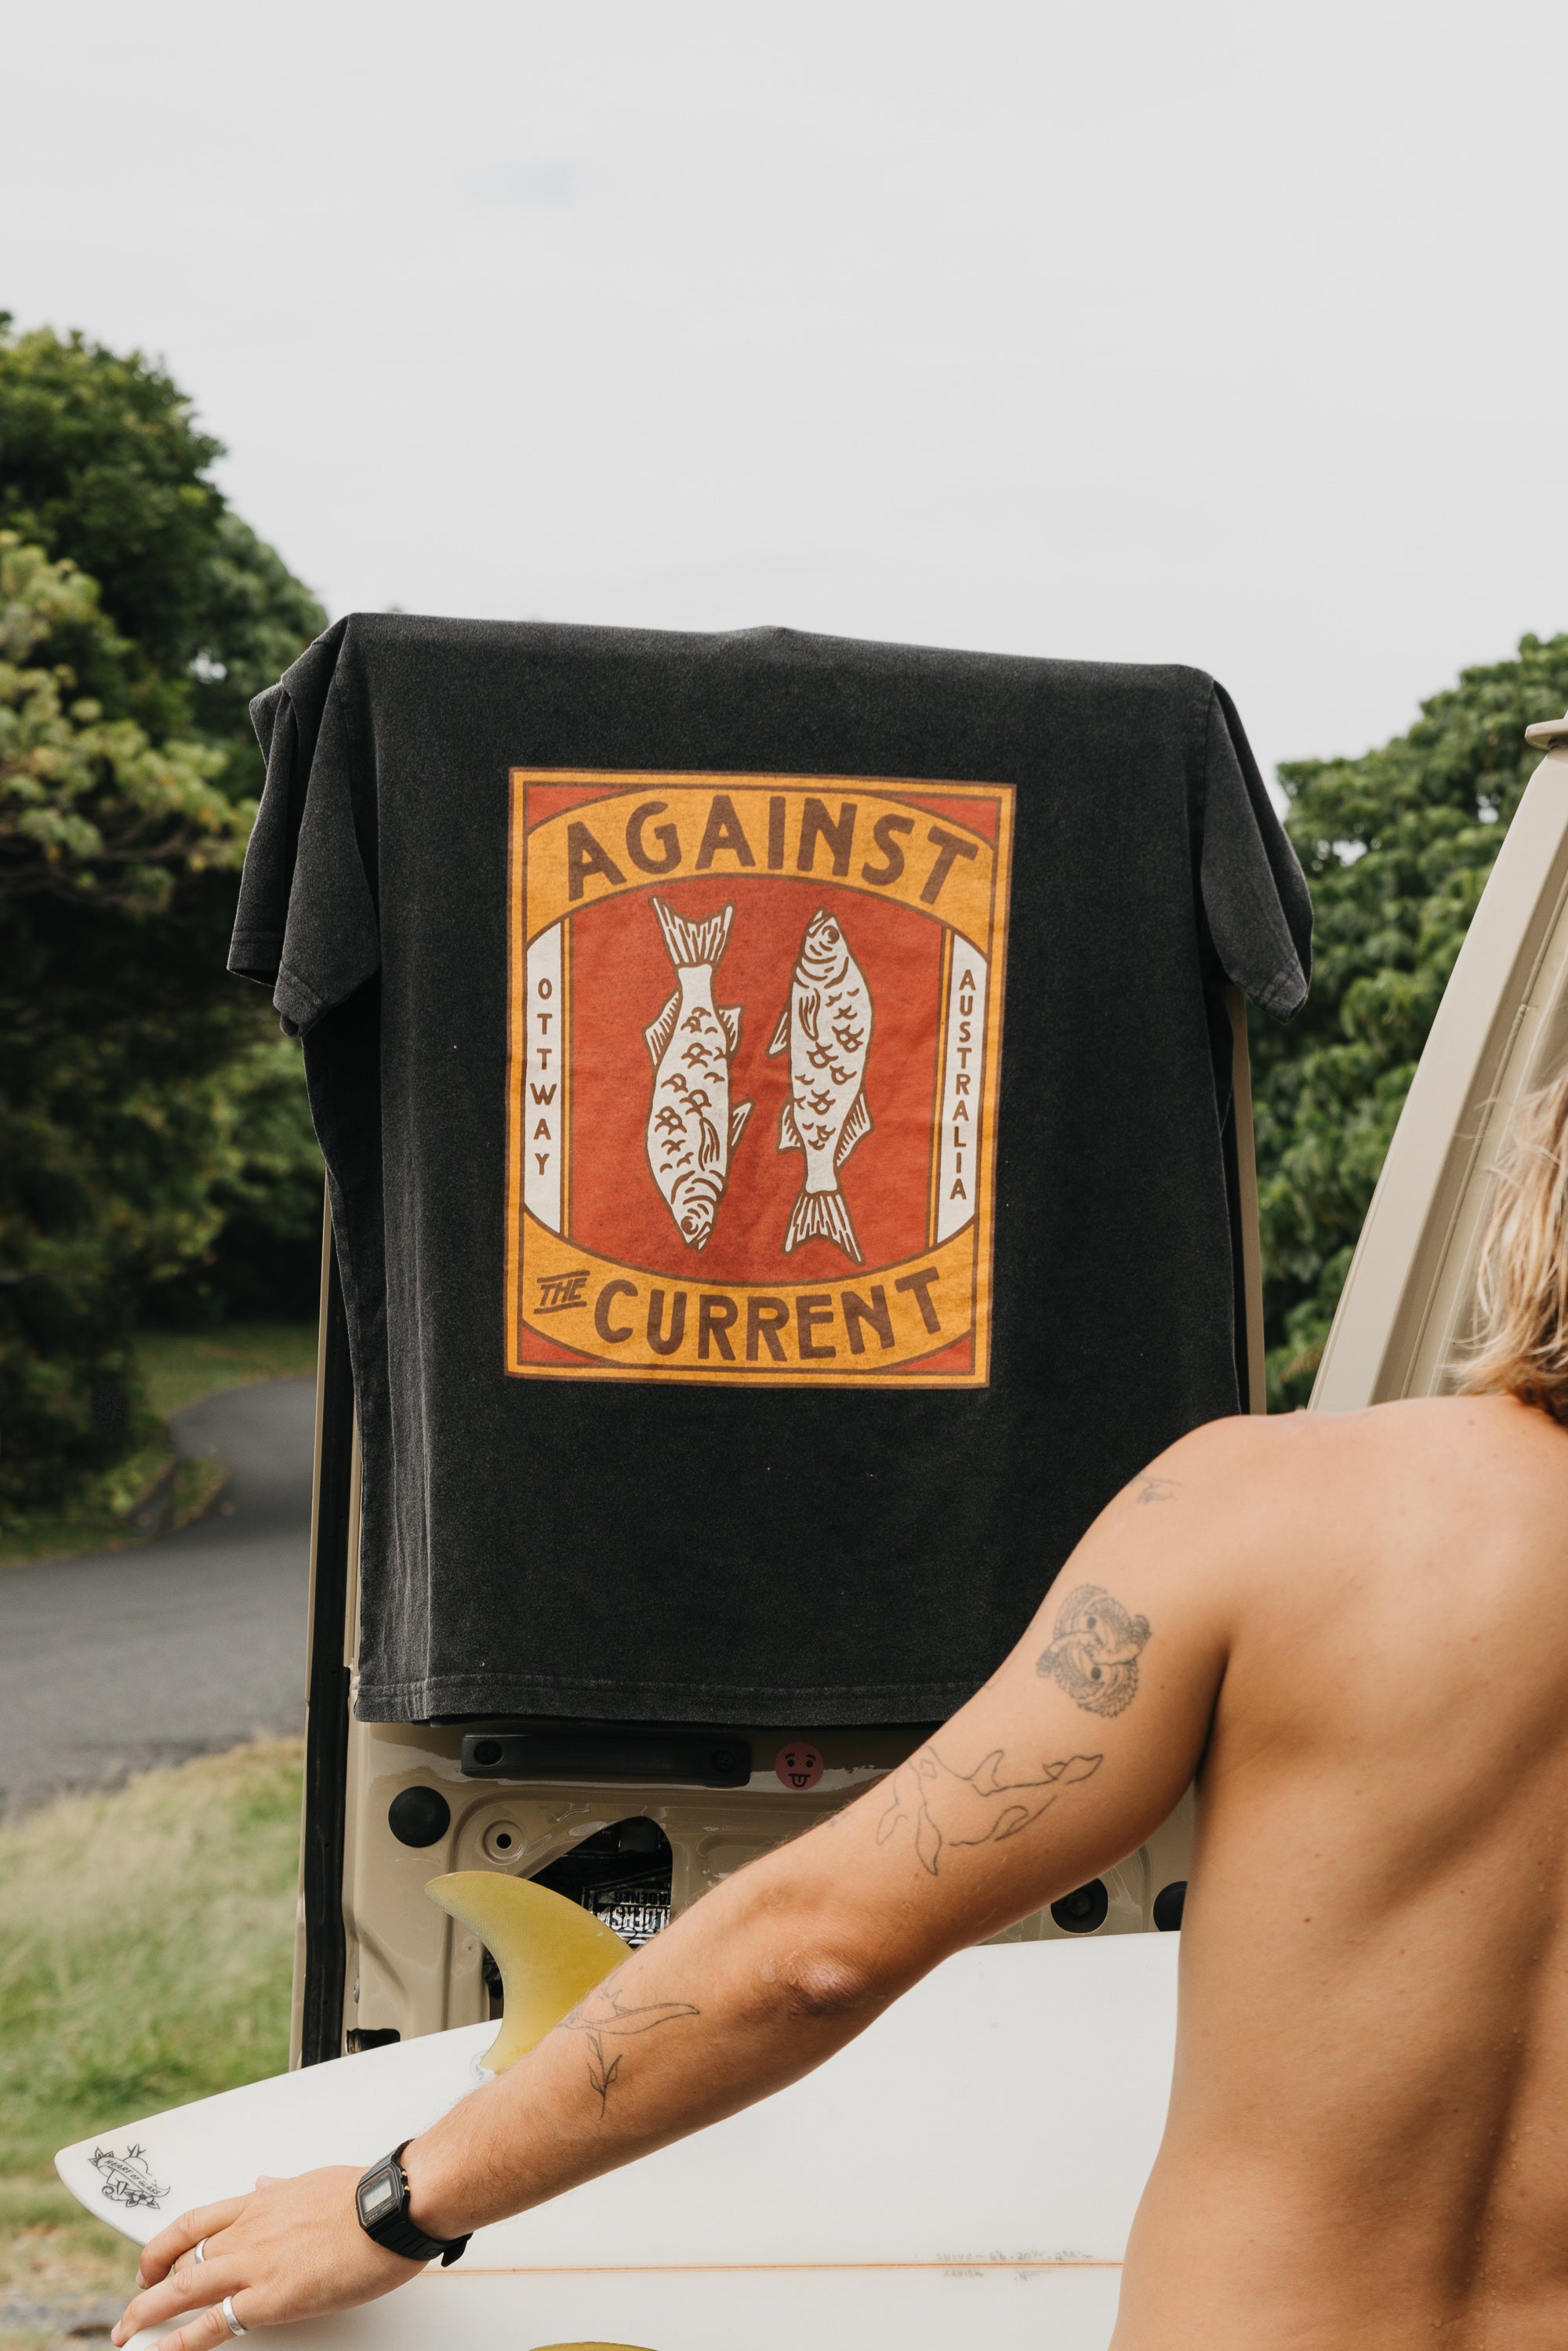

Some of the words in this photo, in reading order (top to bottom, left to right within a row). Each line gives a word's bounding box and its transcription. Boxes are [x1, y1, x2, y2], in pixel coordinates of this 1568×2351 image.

[565, 795, 978, 905] AGAINST
[529, 978, 557, 1176] OTTWAY
[949, 969, 976, 1201] AUSTRALIA
[539, 1276, 589, 1308] THE
[593, 1267, 942, 1362] CURRENT
[104, 2160, 134, 2174] HEART
[138, 2180, 162, 2195] GLASS
